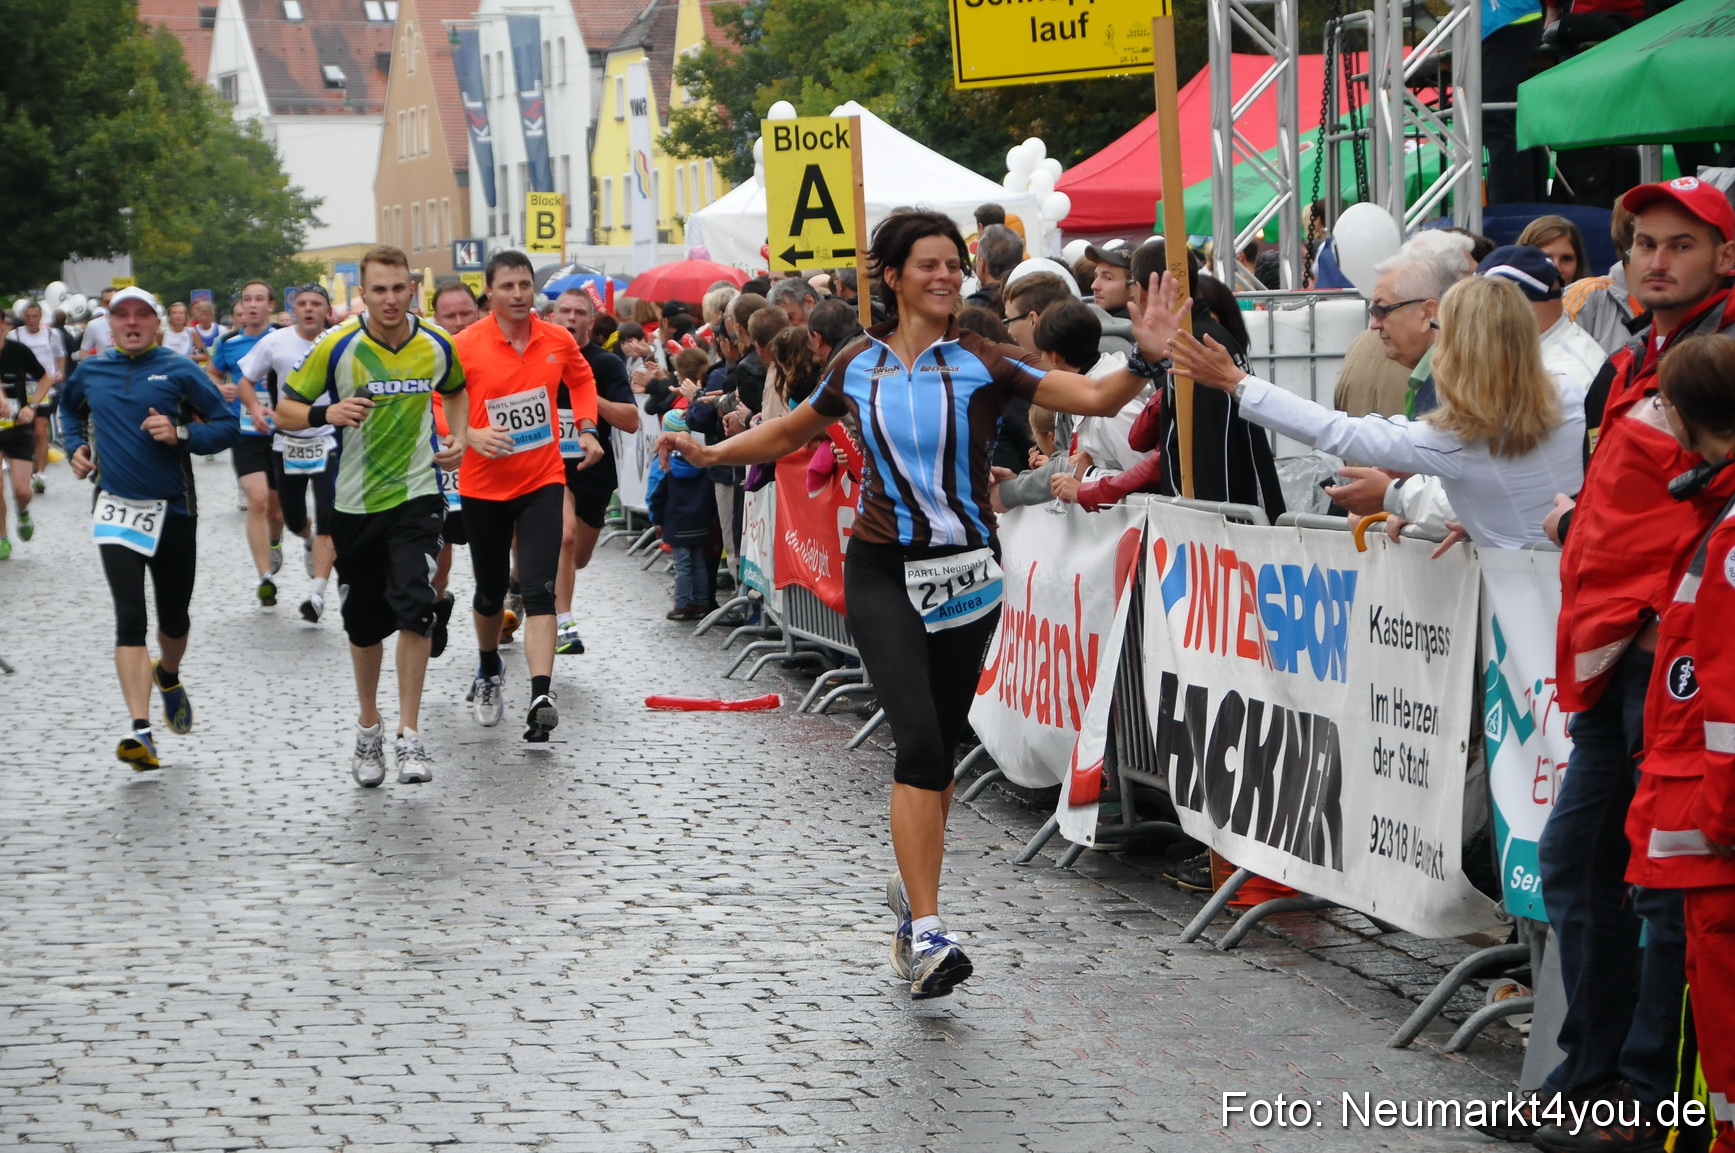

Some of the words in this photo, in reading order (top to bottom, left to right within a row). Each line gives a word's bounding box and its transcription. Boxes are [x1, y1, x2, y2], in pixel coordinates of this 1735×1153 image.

[1030, 12, 1089, 42] lauf
[774, 123, 850, 151] Block
[531, 195, 562, 206] Block
[789, 164, 845, 236] A
[536, 210, 556, 239] B
[367, 379, 432, 395] BOCK
[487, 402, 509, 411] PARTL
[509, 395, 538, 407] Neumarkt
[496, 402, 547, 430] 2639
[288, 445, 323, 459] 2855
[511, 431, 541, 446] ndreas
[101, 504, 156, 532] 3175
[908, 568, 941, 579] PARTL
[940, 596, 982, 617] Andrea
[1184, 540, 1358, 684] INTERSPORT
[1370, 683, 1389, 724] Im
[1393, 687, 1439, 736] Herzen
[1373, 737, 1395, 779] der
[1399, 742, 1430, 789] Stadt
[1369, 814, 1409, 863] 92318
